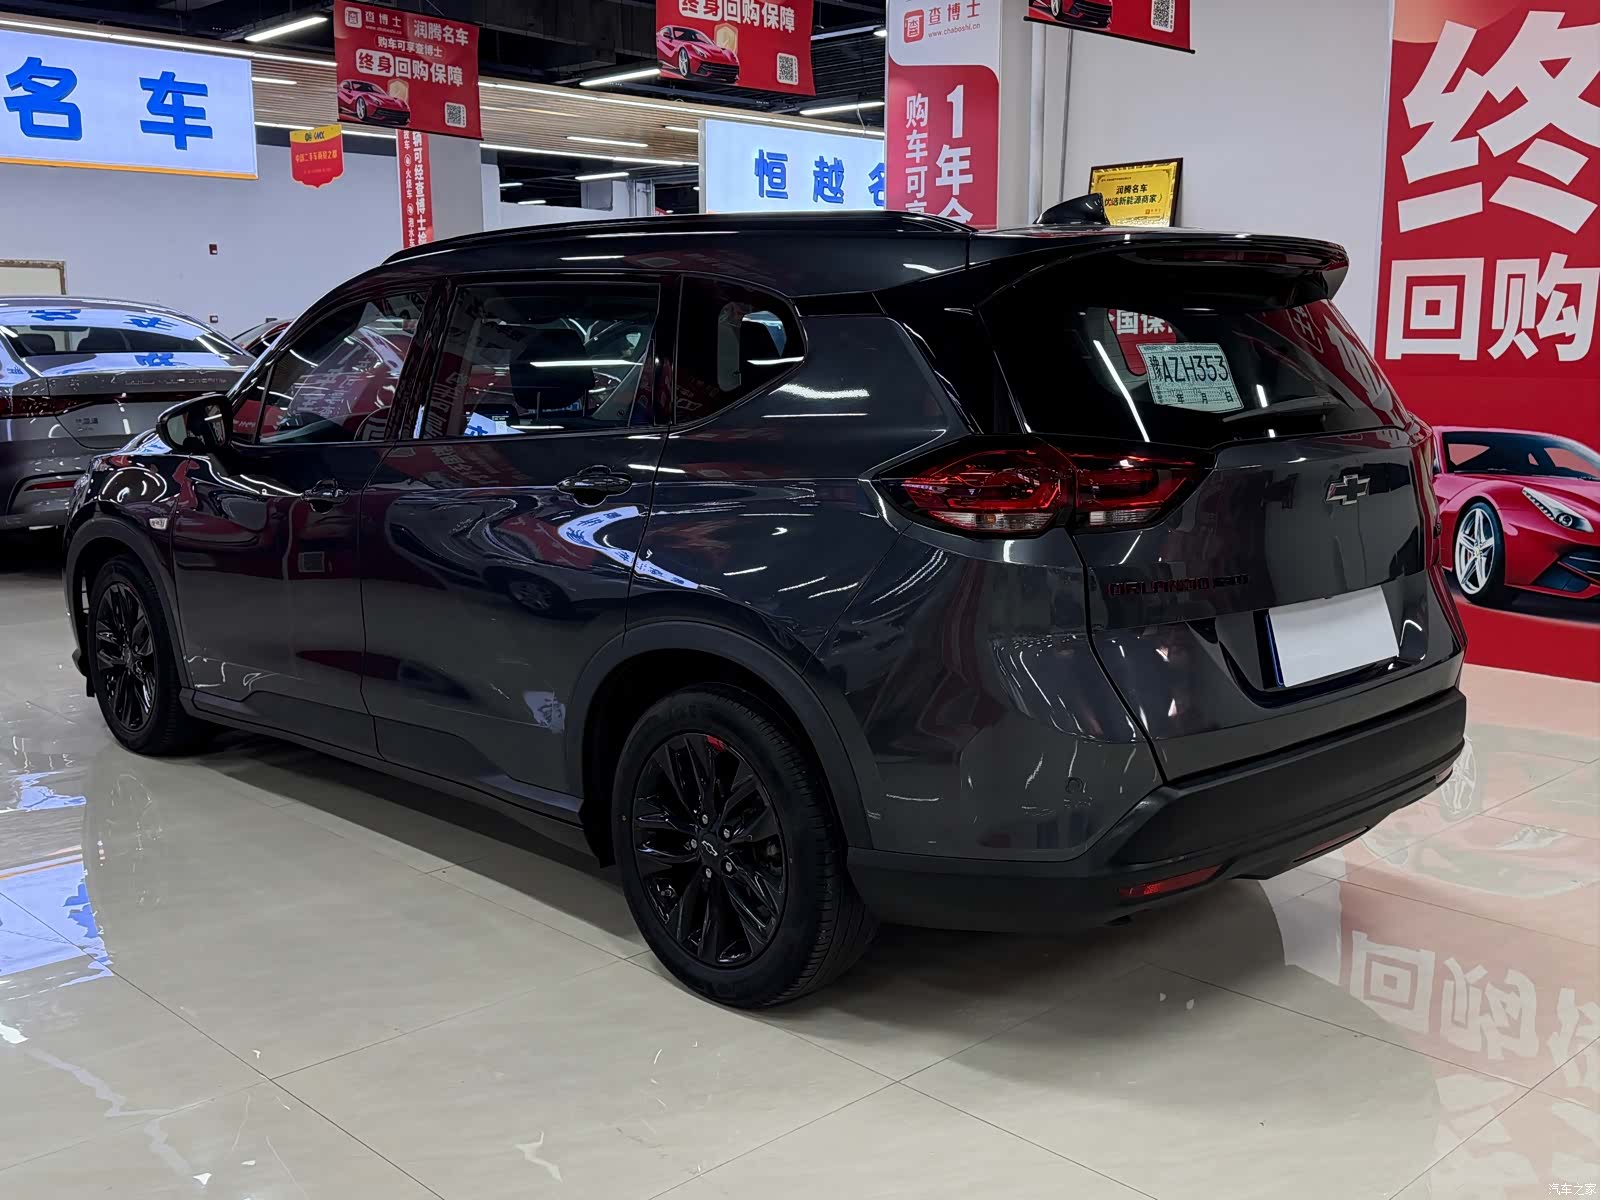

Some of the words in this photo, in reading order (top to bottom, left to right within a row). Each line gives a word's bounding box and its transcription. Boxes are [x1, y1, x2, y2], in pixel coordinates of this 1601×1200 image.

[365, 11, 402, 28] 查博士
[928, 0, 981, 26] 查博士
[413, 19, 469, 46] 润腾名车
[928, 23, 981, 38] www.chaboshi.cn
[377, 36, 442, 58] 购车可享查博士
[358, 52, 463, 87] 终身回购保障
[3, 56, 213, 150] 名车
[1385, 251, 1600, 361] 回购
[1109, 309, 1173, 335] 国保
[1149, 355, 1229, 383] 豫AZH353
